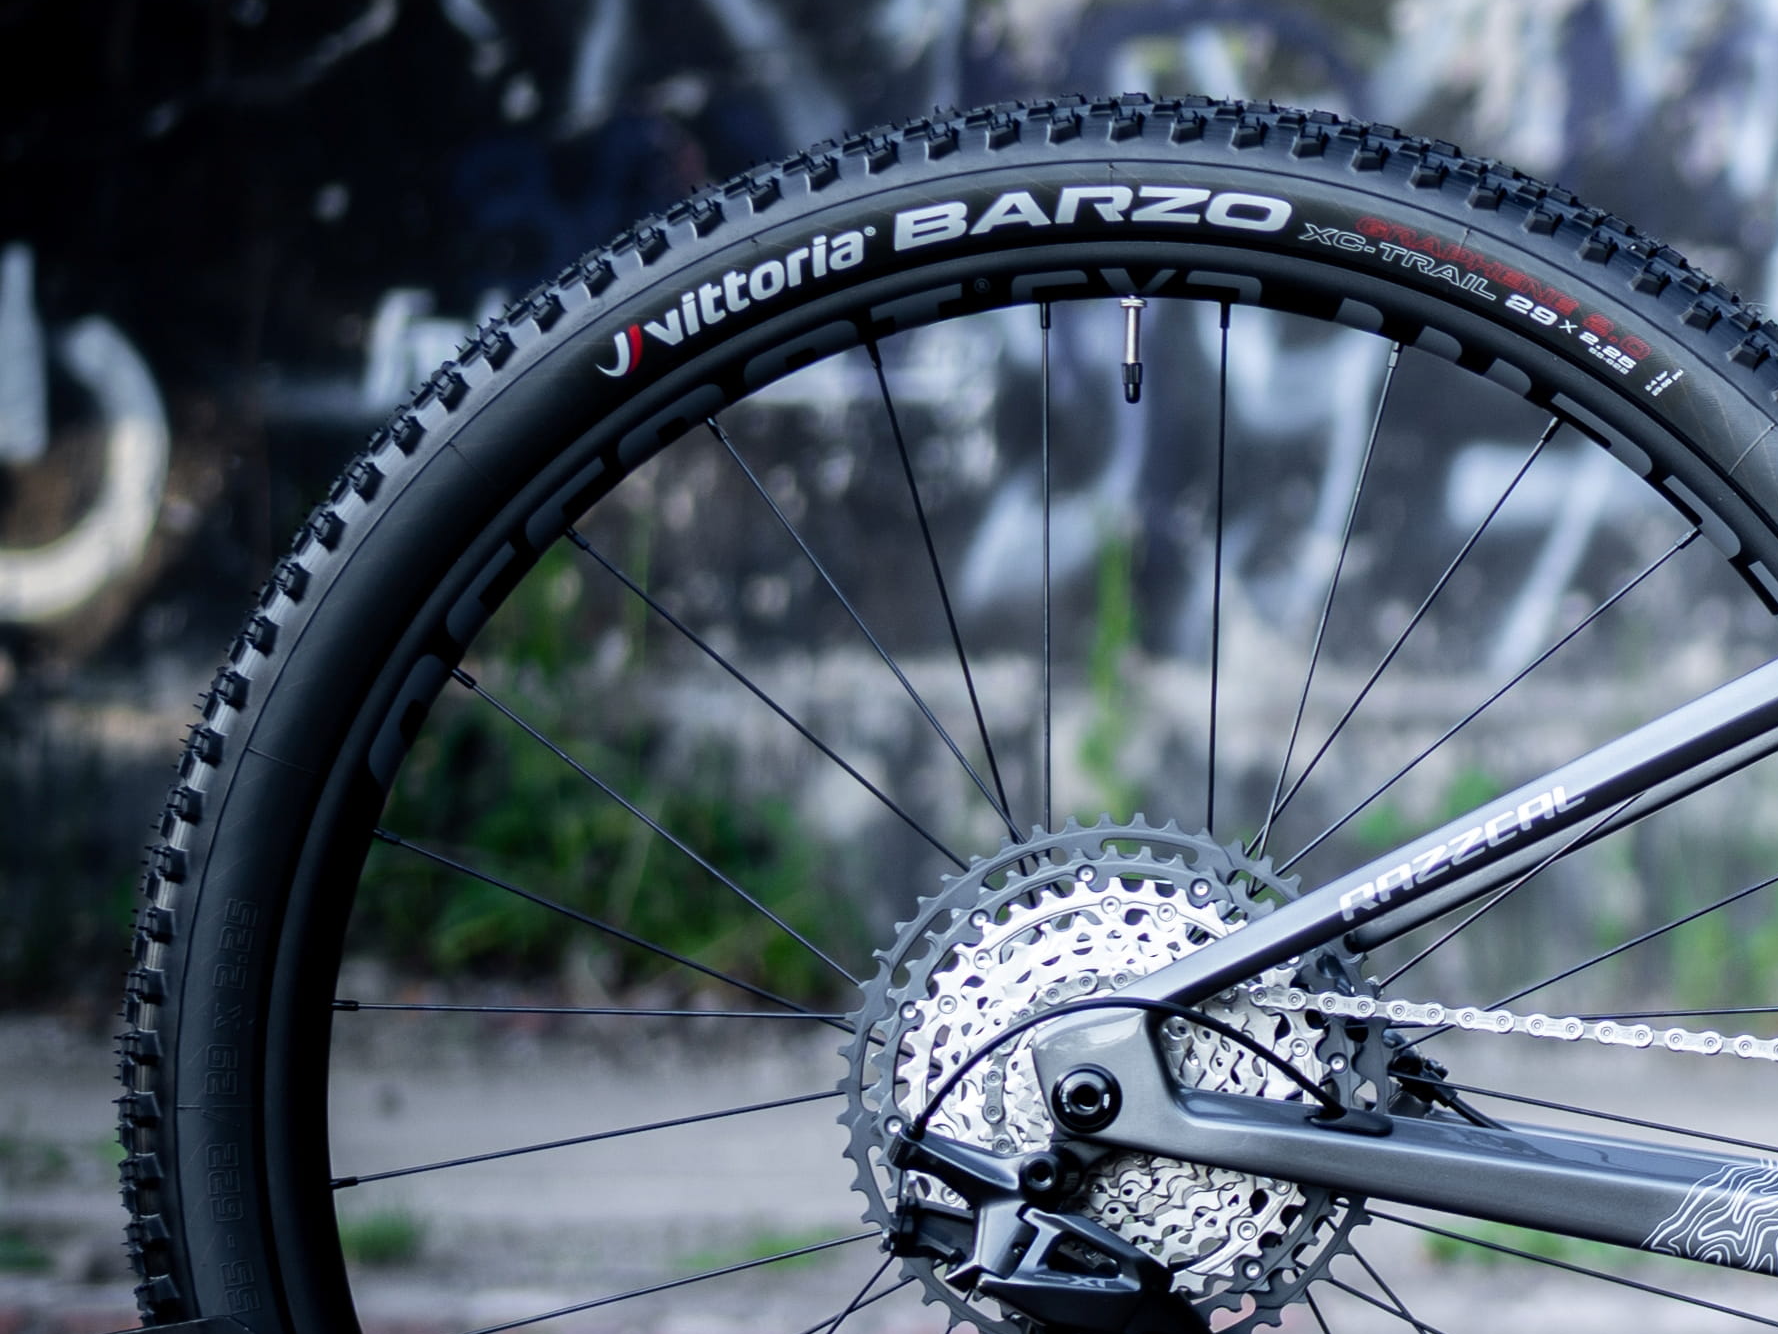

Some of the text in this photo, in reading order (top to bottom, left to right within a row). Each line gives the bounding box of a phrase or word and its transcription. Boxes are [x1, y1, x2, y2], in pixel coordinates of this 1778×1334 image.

[894, 184, 1292, 252] BARZO
[1299, 223, 1497, 302] XC-TRAIL
[1504, 294, 1559, 326] 29
[1579, 331, 1637, 371] 2.25
